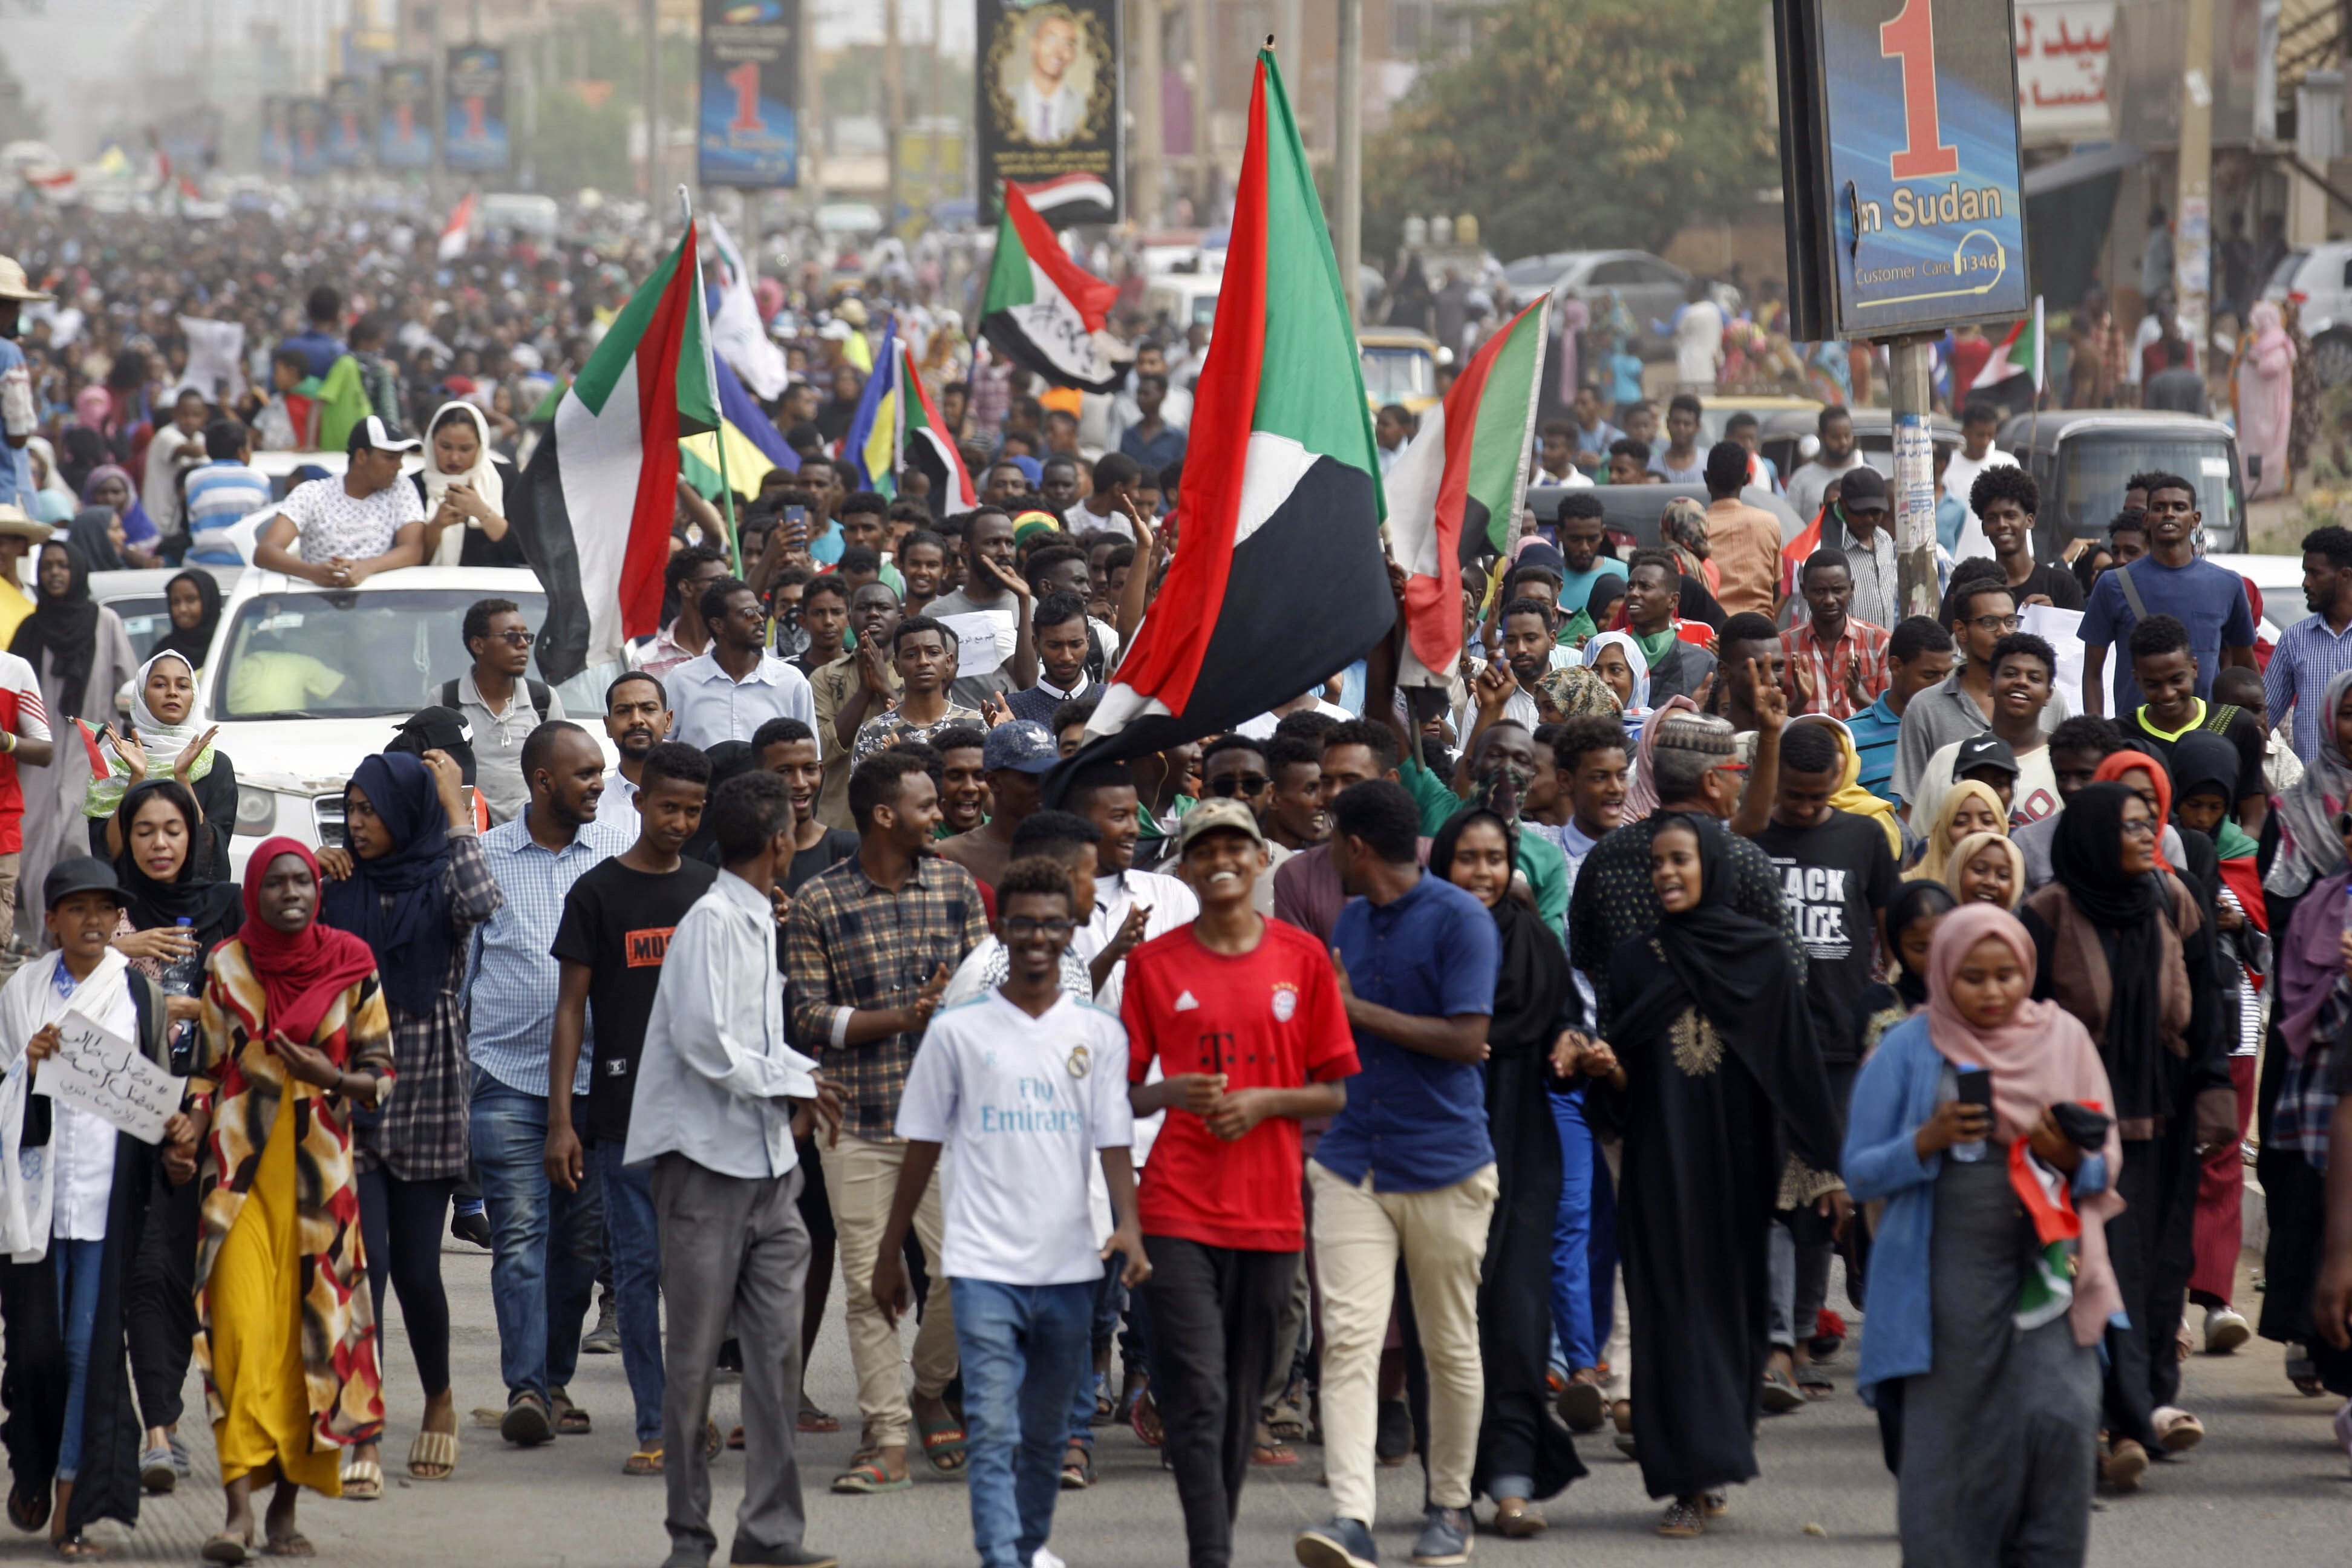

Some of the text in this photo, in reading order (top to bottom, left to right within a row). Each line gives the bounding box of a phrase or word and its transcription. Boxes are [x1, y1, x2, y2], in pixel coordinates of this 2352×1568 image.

[1892, 181, 2002, 230] Sudan
[1855, 253, 1997, 286] Customer Care 1346
[1776, 867, 1846, 902] ACK
[1020, 1077, 1054, 1102] Fly
